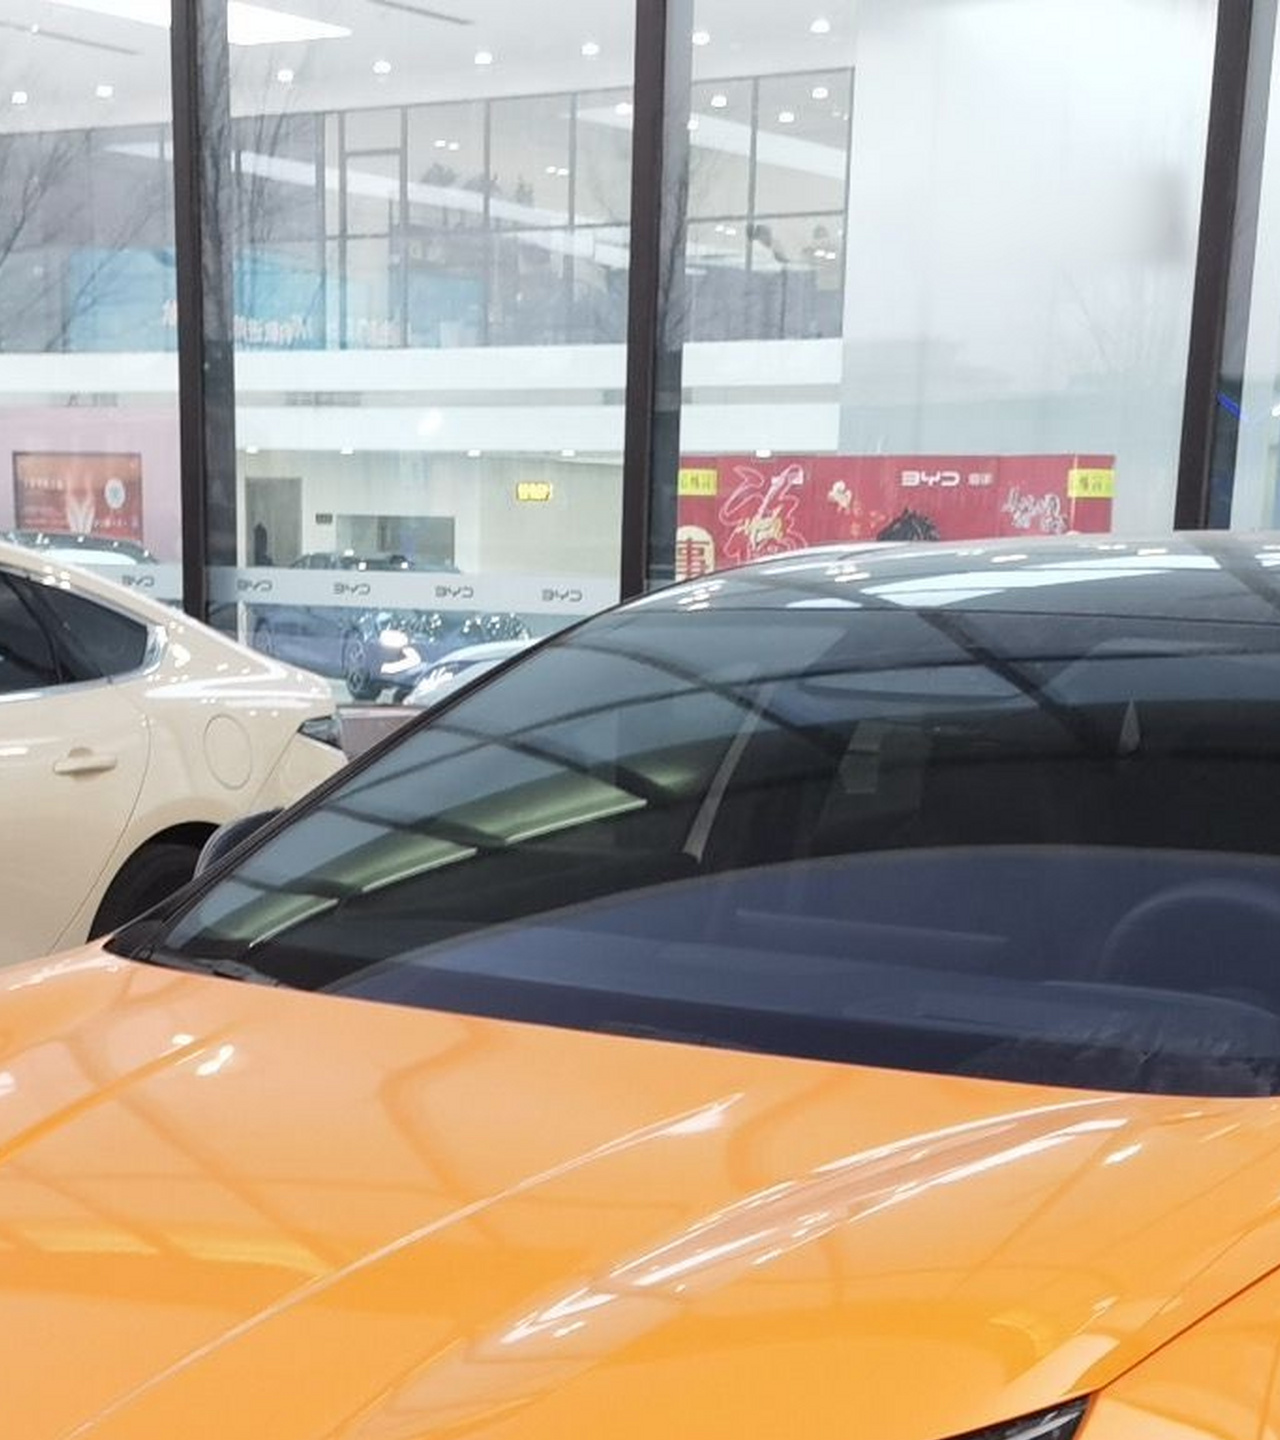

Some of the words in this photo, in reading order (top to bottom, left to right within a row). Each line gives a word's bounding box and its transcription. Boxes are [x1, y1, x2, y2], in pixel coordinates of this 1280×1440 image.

[902, 470, 960, 486] BYD
[122, 575, 154, 588] BYD
[237, 578, 272, 592] BYD
[332, 581, 371, 596] BYD
[435, 585, 474, 600] BYD
[541, 587, 582, 603] BYD
